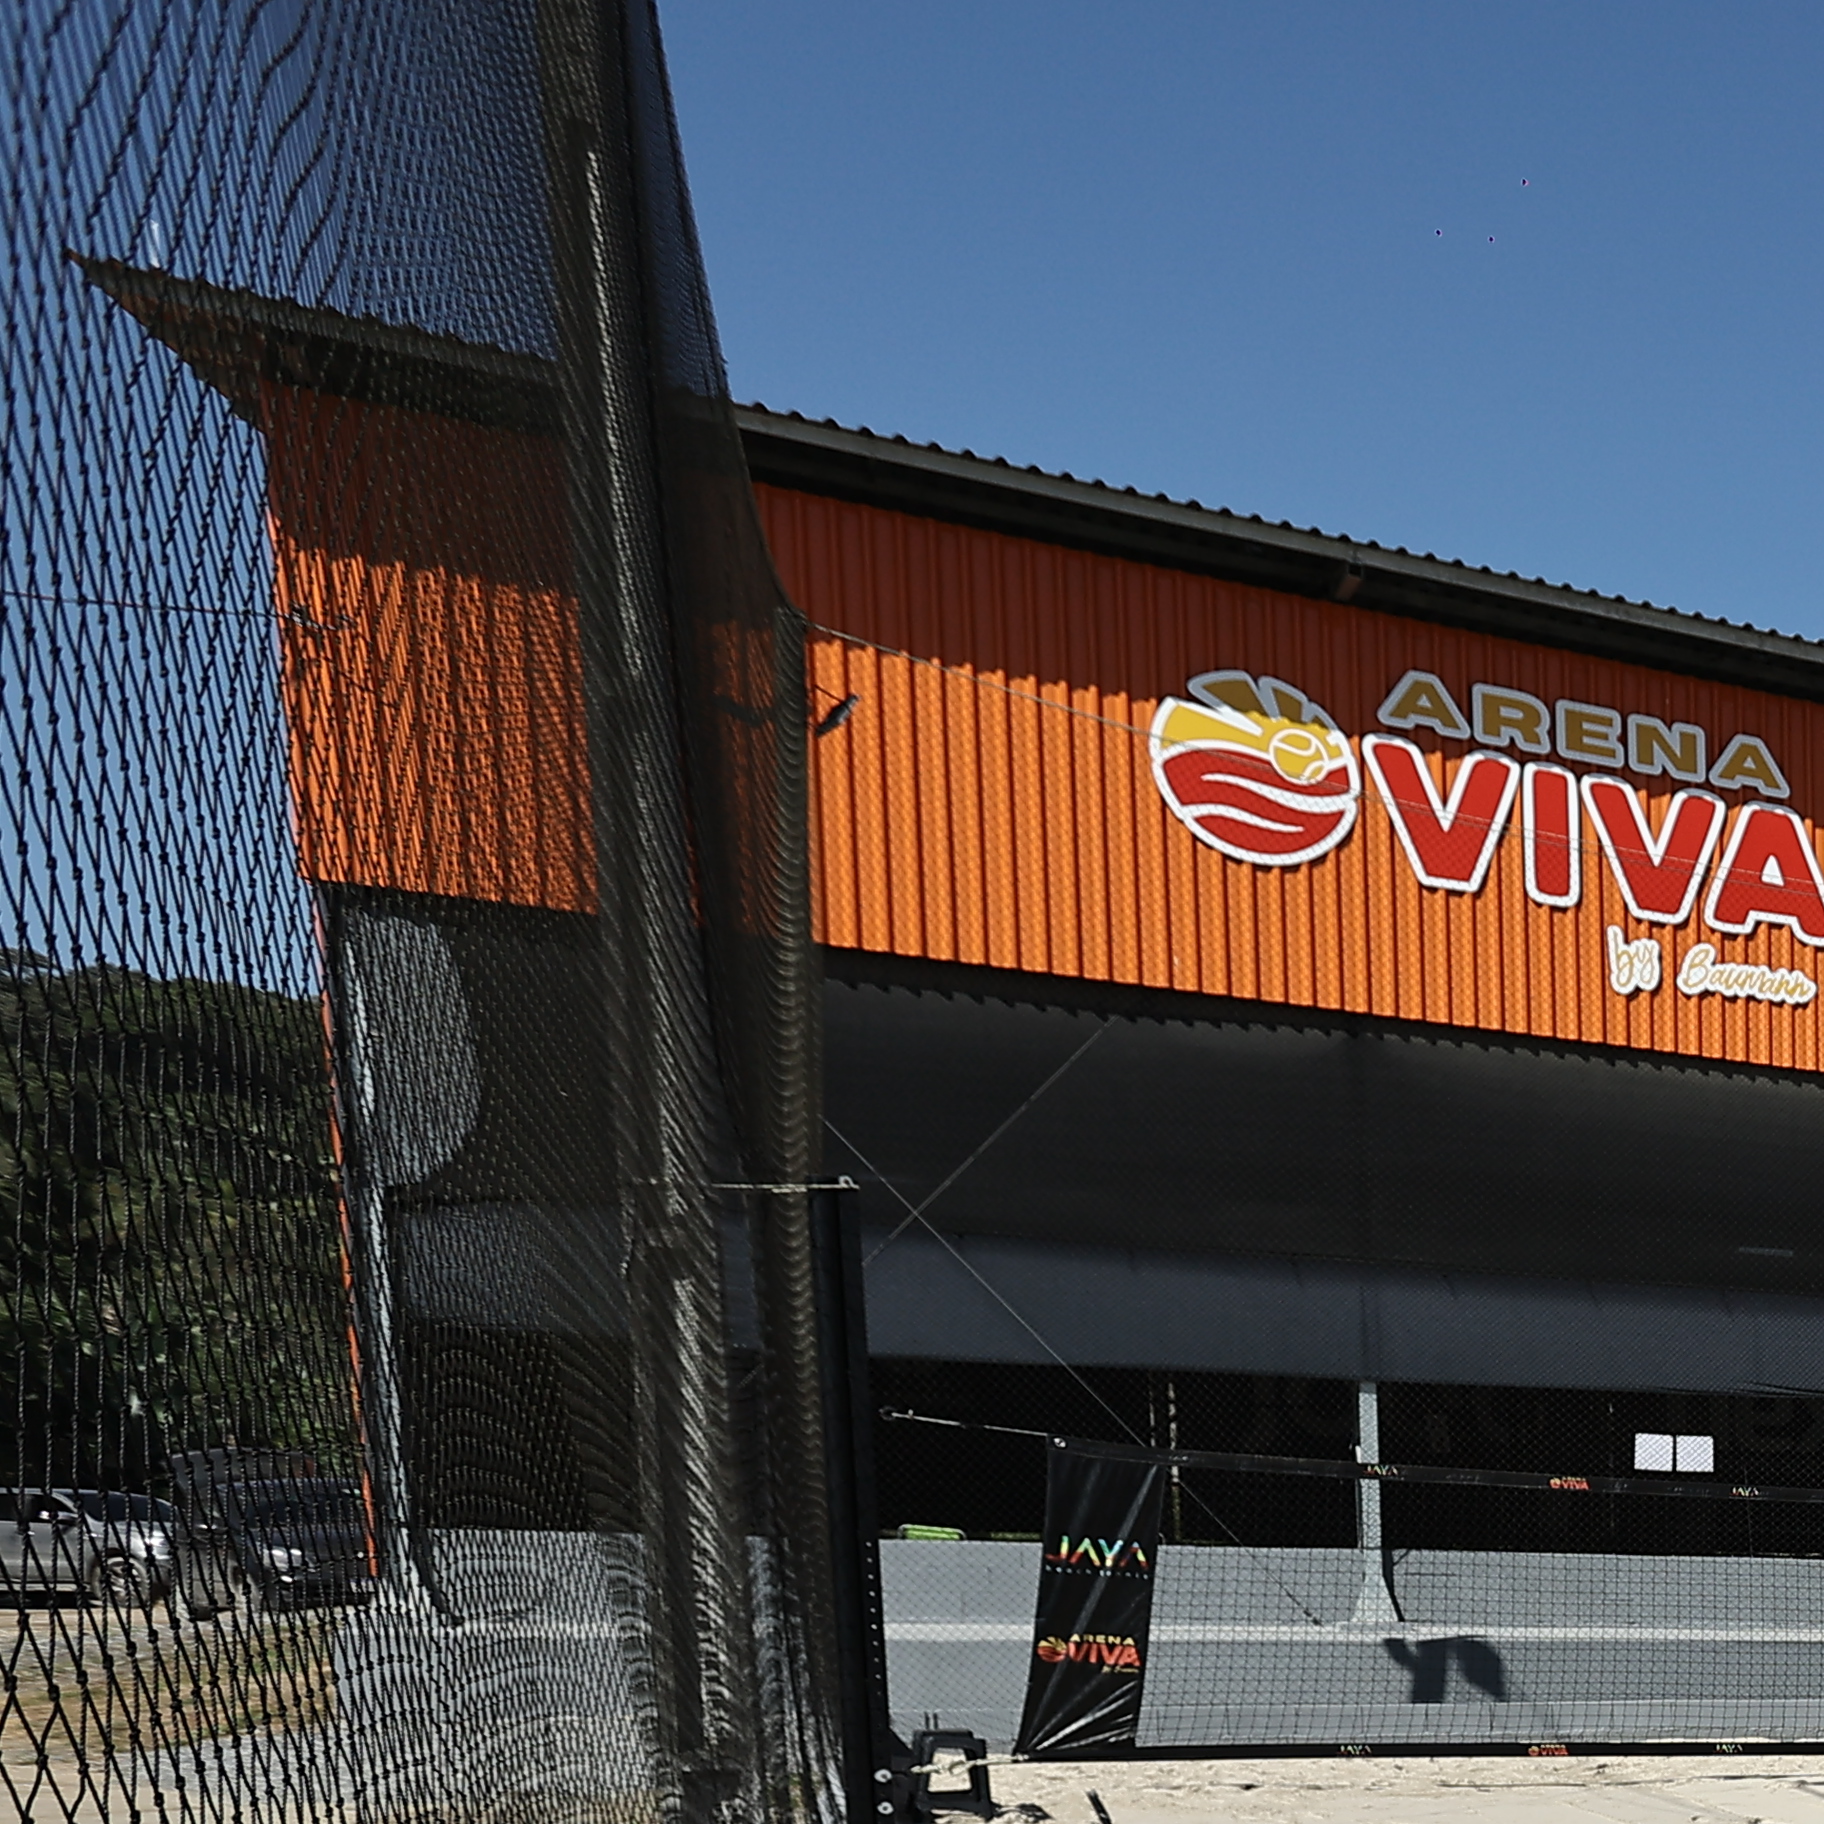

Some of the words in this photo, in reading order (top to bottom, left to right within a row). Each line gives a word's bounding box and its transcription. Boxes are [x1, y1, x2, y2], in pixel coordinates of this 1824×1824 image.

[1376, 670, 1789, 798] ARENA
[1610, 927, 1658, 990] by
[1680, 946, 1813, 999] Baumann
[1562, 1480, 1588, 1490] VIVA
[1045, 1535, 1148, 1569] JAYA
[1069, 1633, 1135, 1645] ARENA
[1068, 1642, 1141, 1666] VIVA
